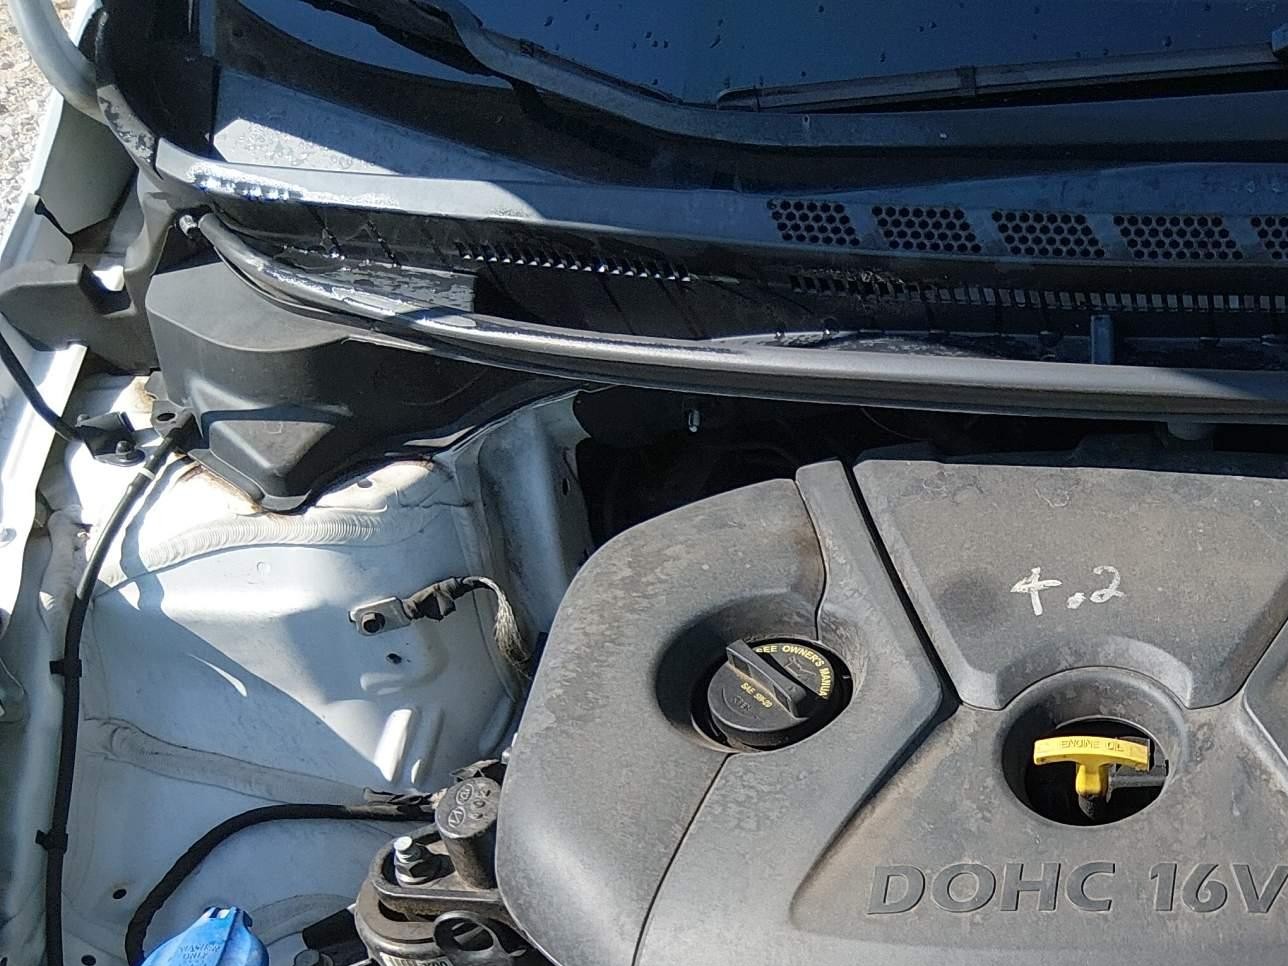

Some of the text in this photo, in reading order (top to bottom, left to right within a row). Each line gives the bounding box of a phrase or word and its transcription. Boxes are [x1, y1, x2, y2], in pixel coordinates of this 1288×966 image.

[1010, 566, 1126, 616] 4.2
[755, 644, 833, 698] SEE OWNER'S MANUA
[866, 862, 1116, 915] DOHC
